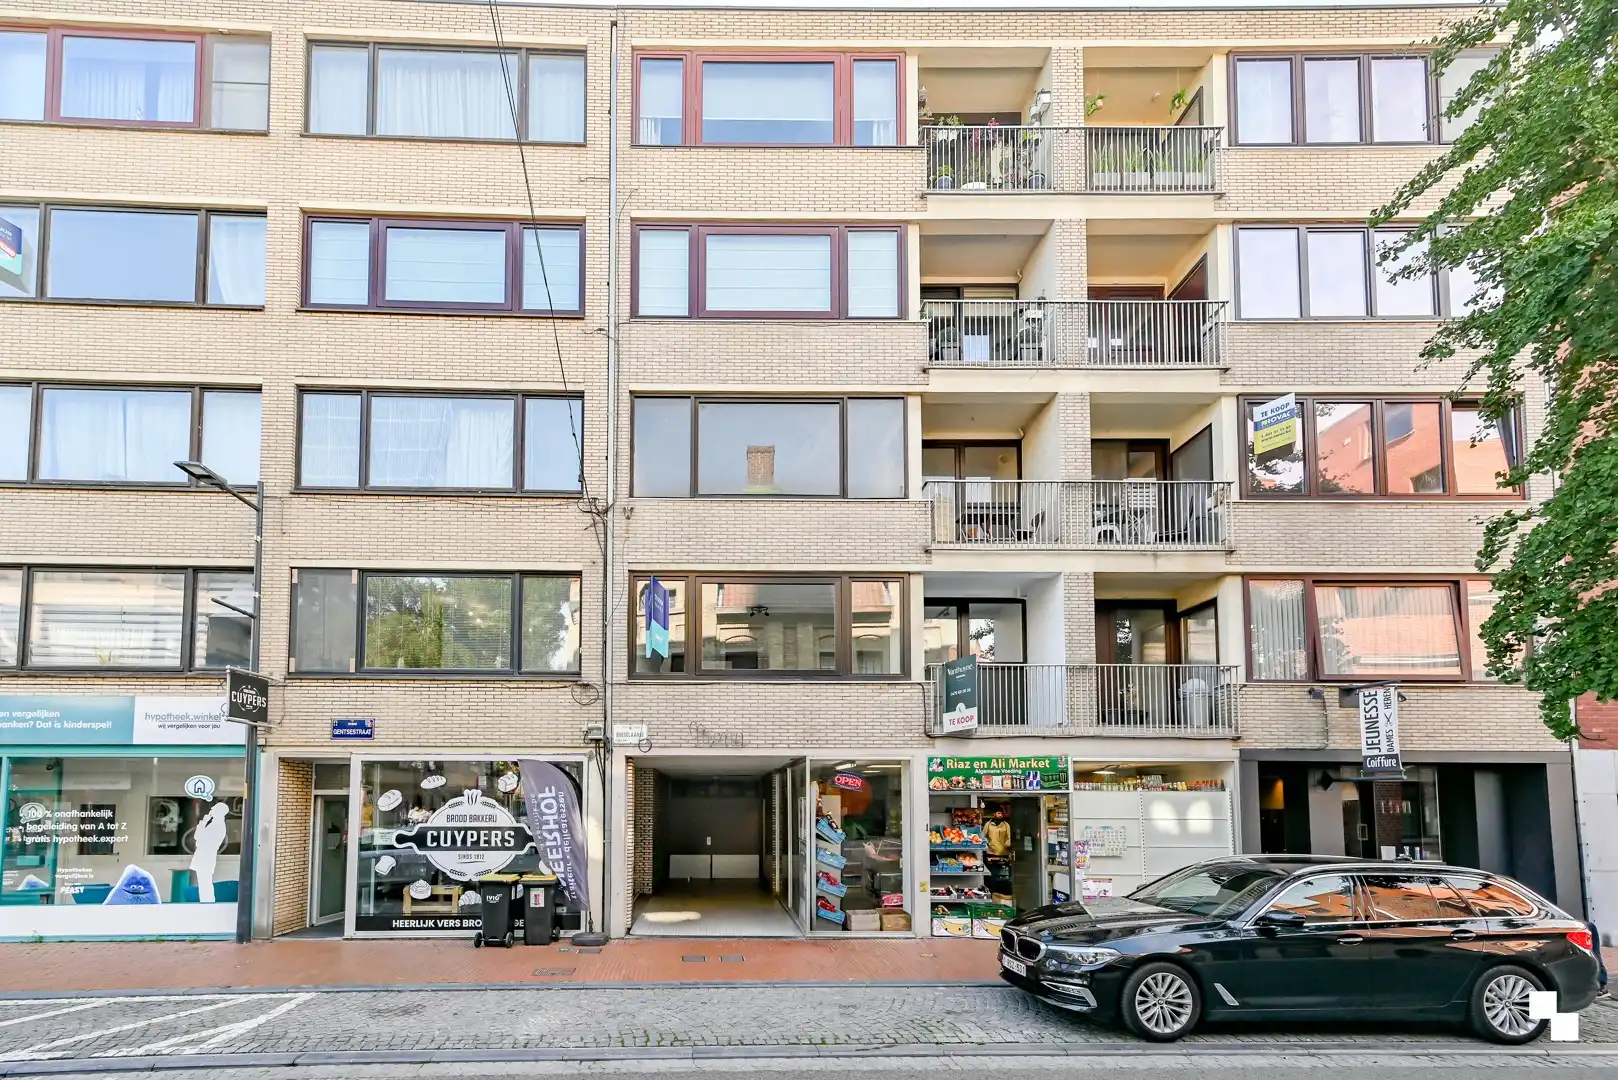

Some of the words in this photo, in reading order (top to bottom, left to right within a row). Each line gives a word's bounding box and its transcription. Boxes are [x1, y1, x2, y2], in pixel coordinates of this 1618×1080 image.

[1270, 402, 1290, 414] KOOP
[231, 690, 267, 708] CUYPERS
[1383, 688, 1392, 710] HEREN
[144, 712, 221, 722] hypotheek.winkel
[949, 718, 956, 726] TE
[956, 715, 974, 725] KOOP
[1363, 690, 1381, 753] JEUNESSE
[0, 720, 34, 729] anken?
[36, 721, 52, 729] Dat
[54, 721, 61, 729] is
[63, 720, 112, 730] kinderspel!
[1385, 729, 1395, 752] DAMES
[946, 758, 971, 769] Riaz
[973, 761, 988, 769] en
[990, 758, 1006, 769] Ali
[1007, 758, 1050, 769] Market
[1366, 756, 1397, 768] Coiffure
[834, 776, 862, 788] OPEN
[27, 810, 42, 818] 100
[45, 810, 52, 818] %
[54, 809, 113, 820] onafhankelijk
[446, 814, 468, 823] BROOD
[26, 822, 78, 833] begeleiding
[97, 822, 105, 830] A
[106, 822, 119, 830] tot
[120, 822, 127, 830] Z
[53, 834, 129, 845] hypotheek.expert
[426, 830, 515, 847] CUYPERS
[392, 919, 435, 928] HEERLIJK
[437, 919, 461, 928] VERS
[463, 919, 483, 928] BRO
